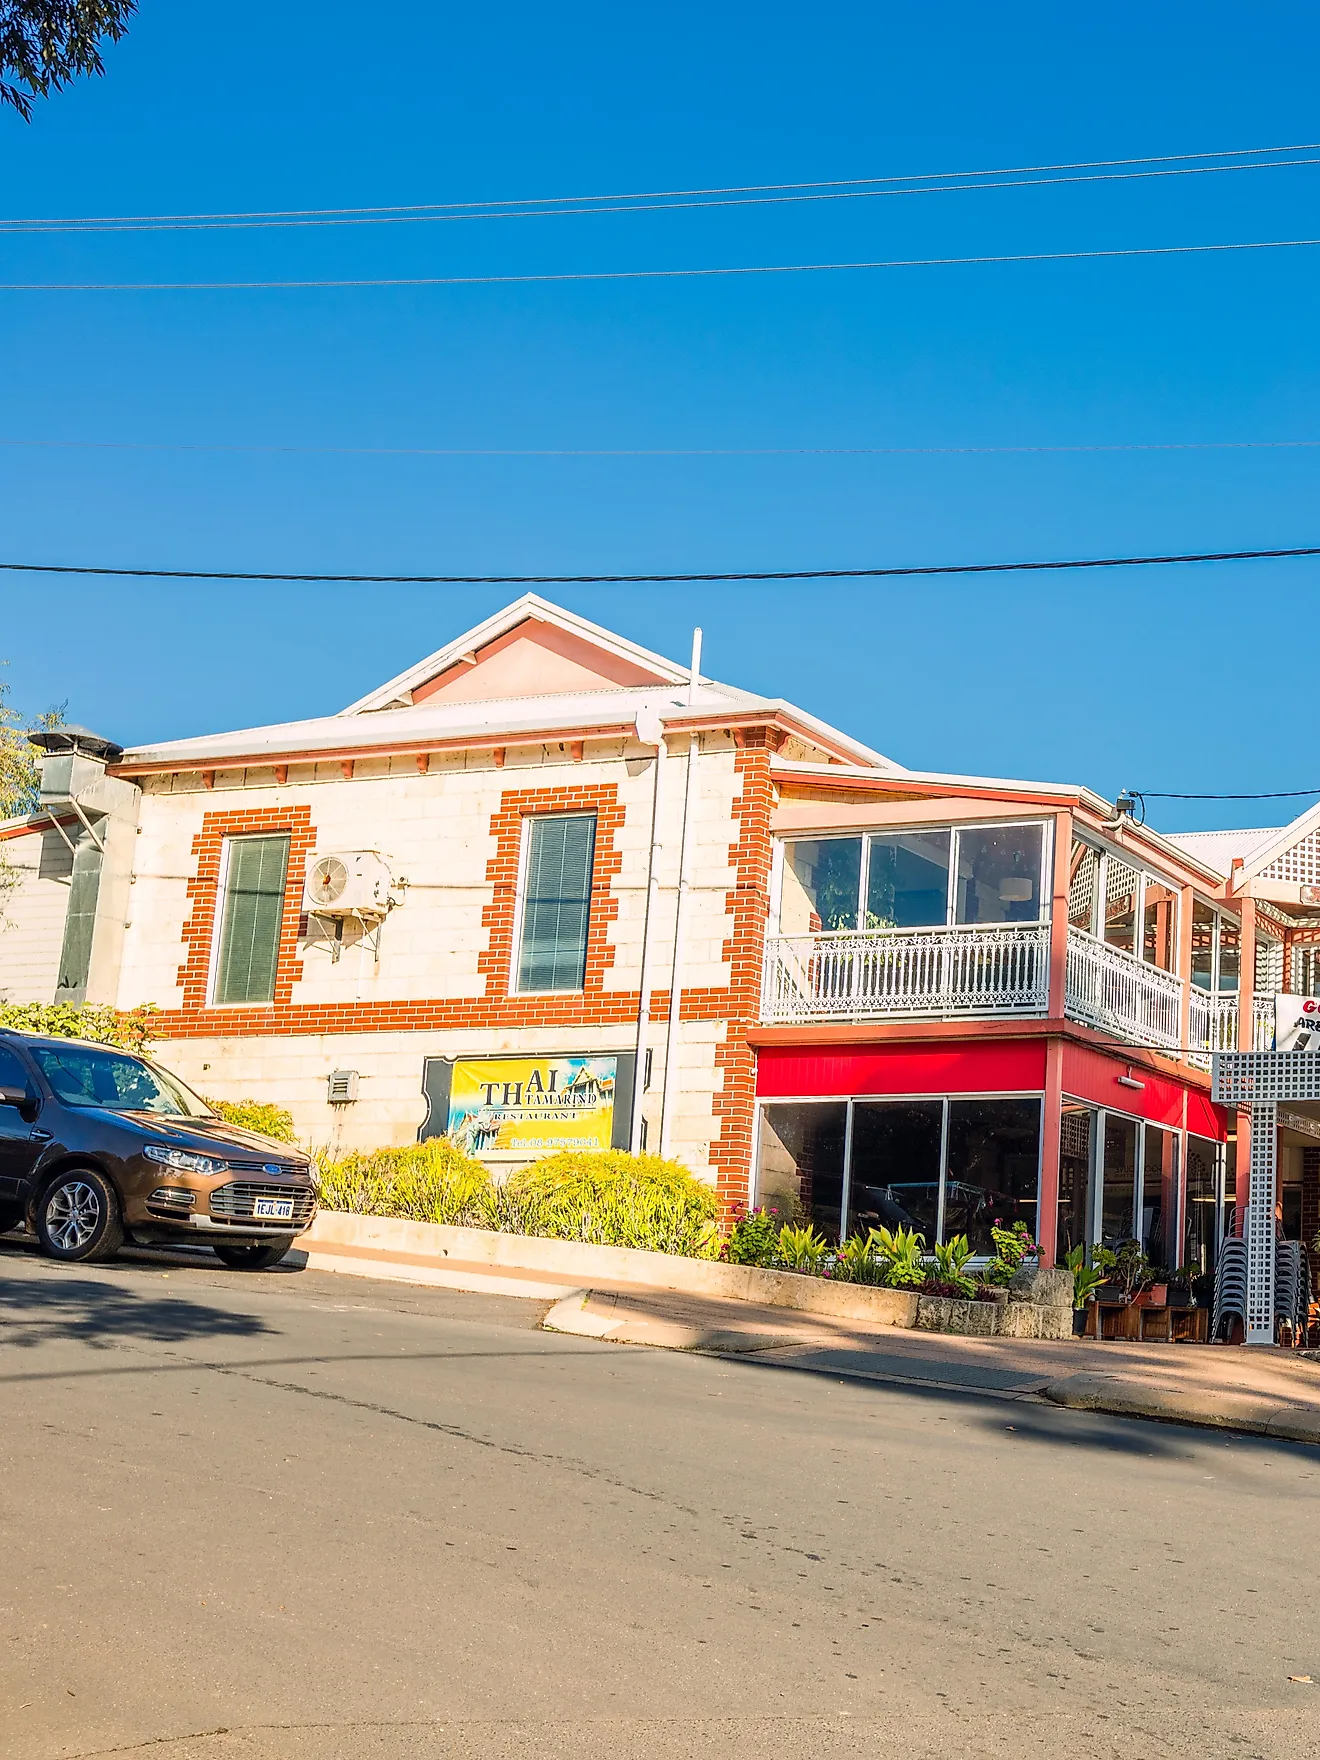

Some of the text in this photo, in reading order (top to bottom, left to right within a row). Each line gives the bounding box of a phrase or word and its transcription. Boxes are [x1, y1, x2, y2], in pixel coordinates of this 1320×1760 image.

[479, 1069, 559, 1106] THAI
[525, 1093, 597, 1105] TAMARIND
[494, 1111, 576, 1120] RESTAURANT
